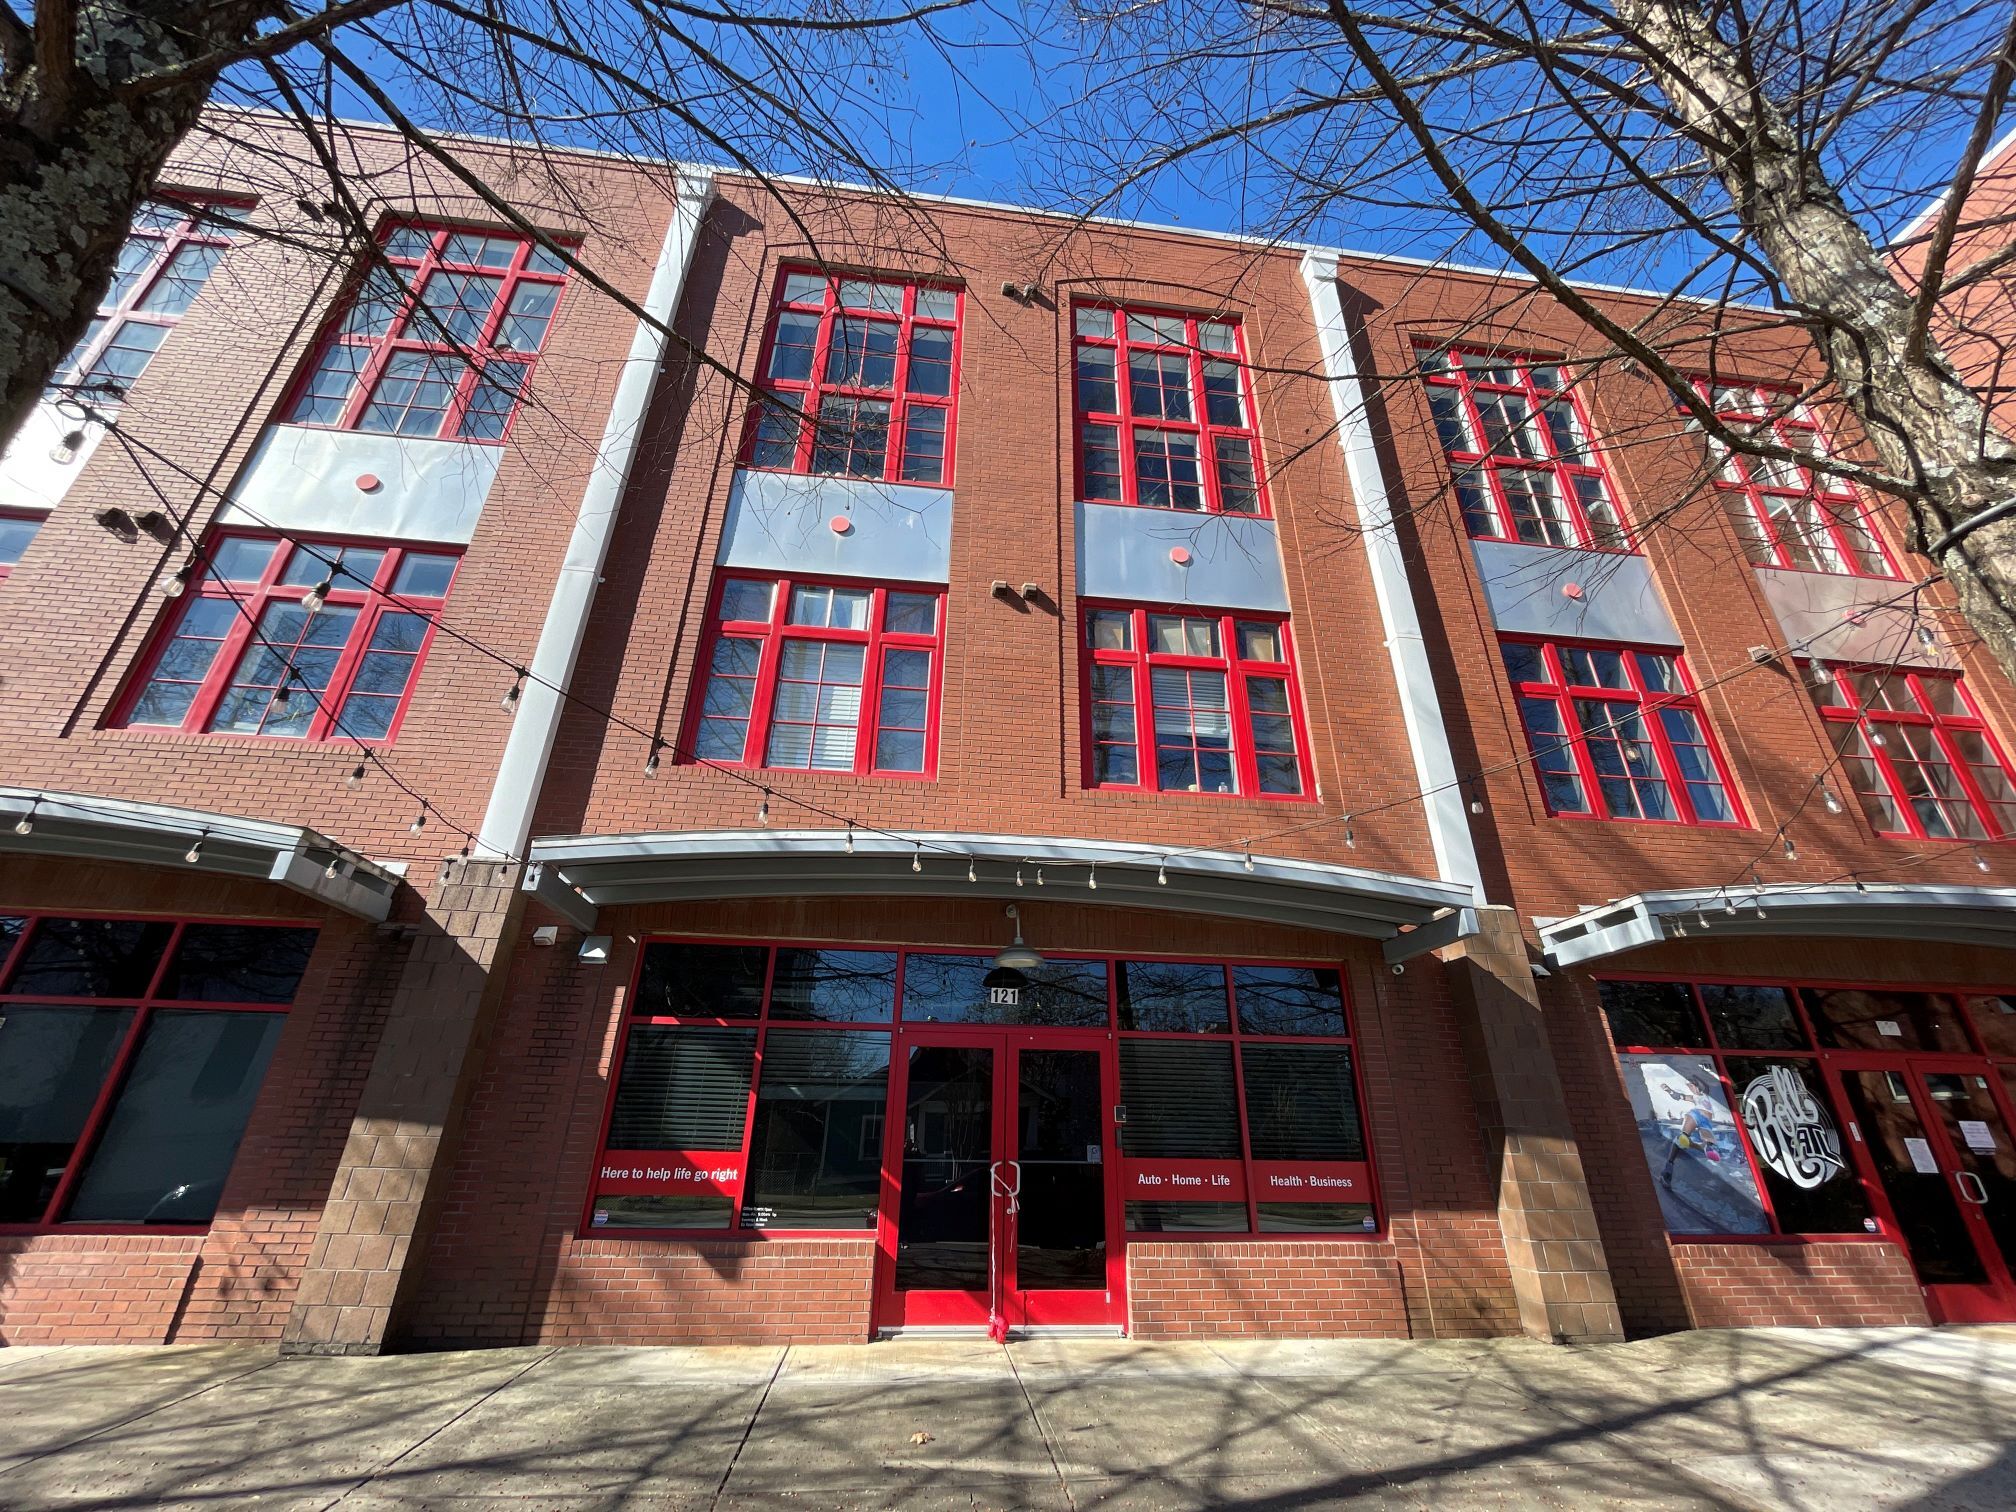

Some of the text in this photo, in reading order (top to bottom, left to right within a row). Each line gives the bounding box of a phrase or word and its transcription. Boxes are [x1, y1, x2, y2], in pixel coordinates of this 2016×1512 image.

[992, 989, 1016, 1003] 121
[601, 1166, 738, 1182] Here to help life go right
[1138, 1173, 1231, 1186] Auto Home Life
[1270, 1175, 1353, 1188] Health Business
